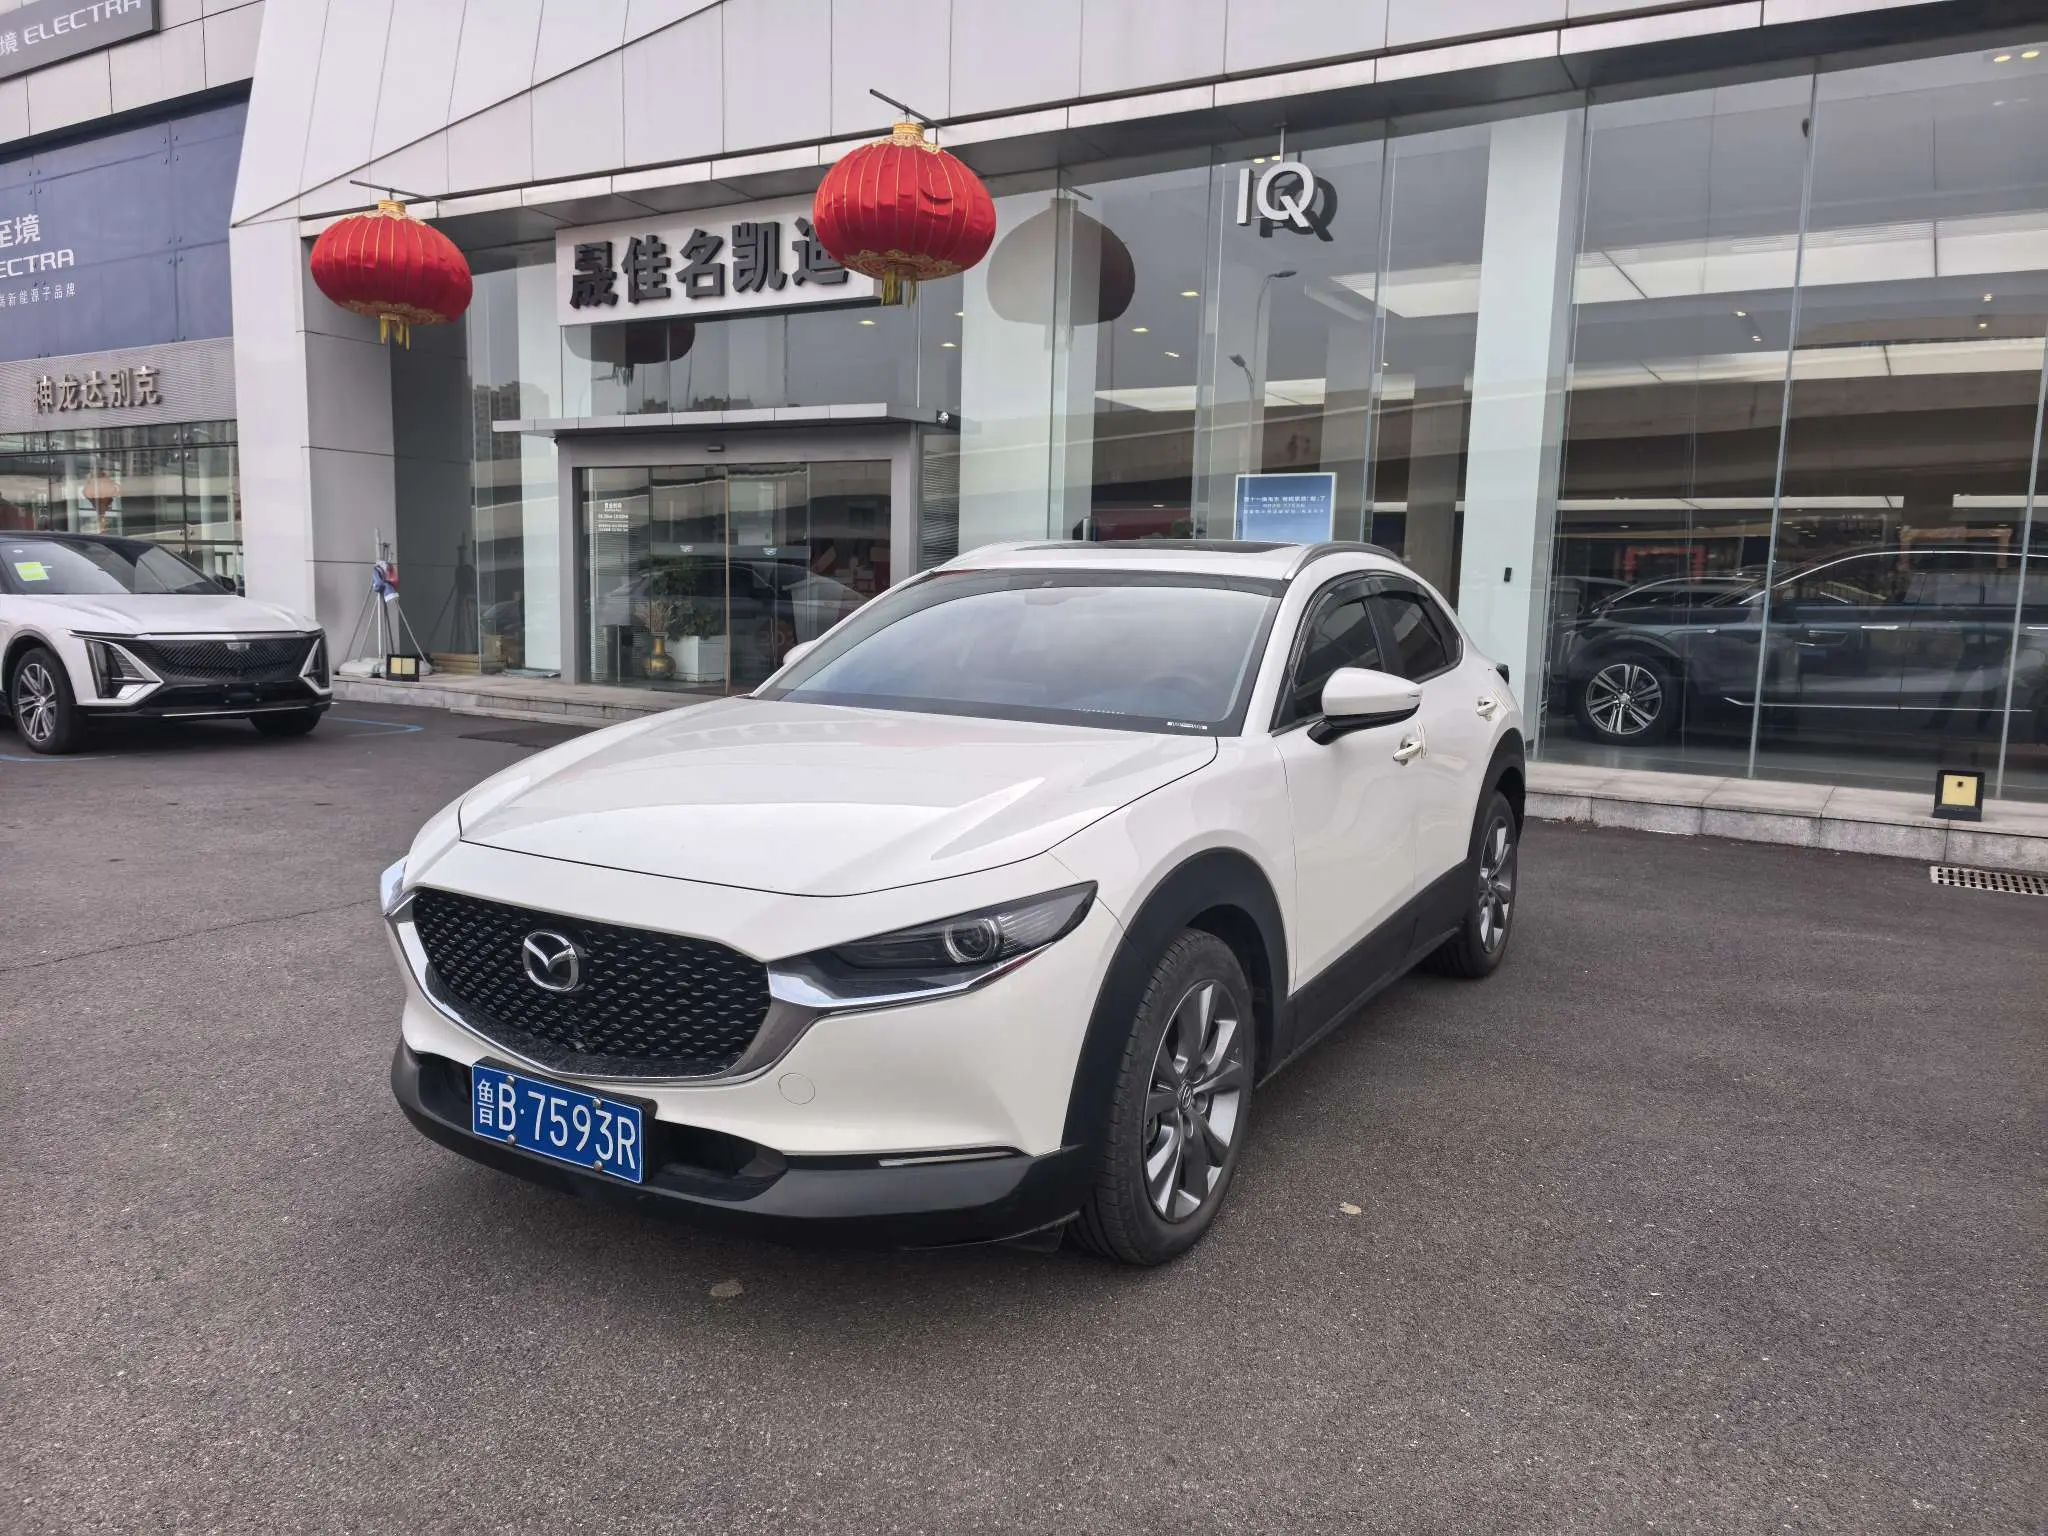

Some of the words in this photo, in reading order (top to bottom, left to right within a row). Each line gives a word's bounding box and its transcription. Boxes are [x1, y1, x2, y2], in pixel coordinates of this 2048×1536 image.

[24, 0, 141, 45] ELECTRA
[1237, 162, 1314, 228] IQ
[33, 365, 162, 414] 神龙达别克
